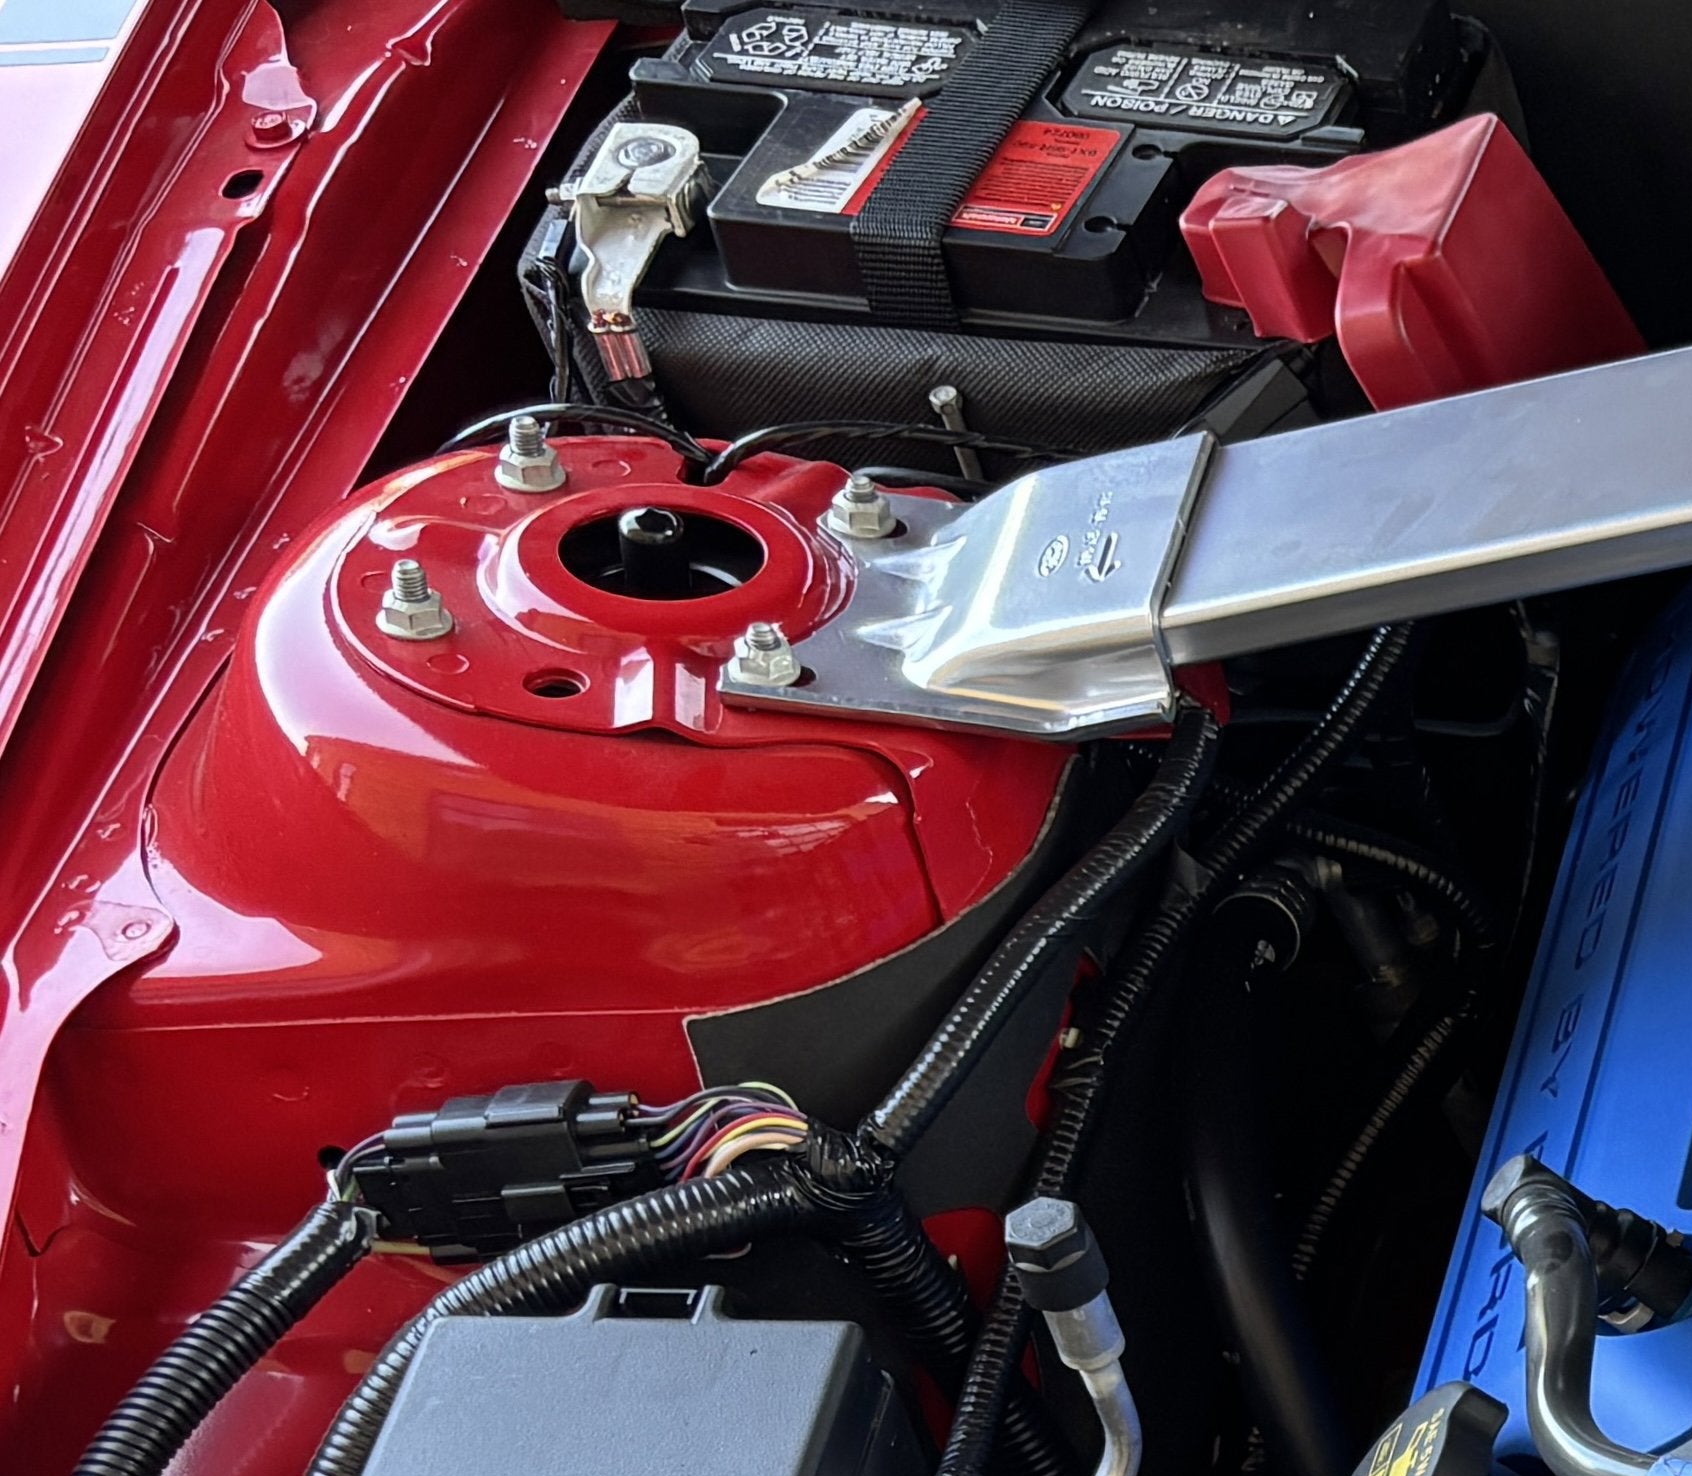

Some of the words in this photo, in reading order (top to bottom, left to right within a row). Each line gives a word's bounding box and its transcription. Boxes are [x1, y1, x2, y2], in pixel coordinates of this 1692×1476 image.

[1090, 95, 1169, 113] POISON
[1188, 103, 1274, 124] DANGER
[1537, 1008, 1589, 1099] BY
